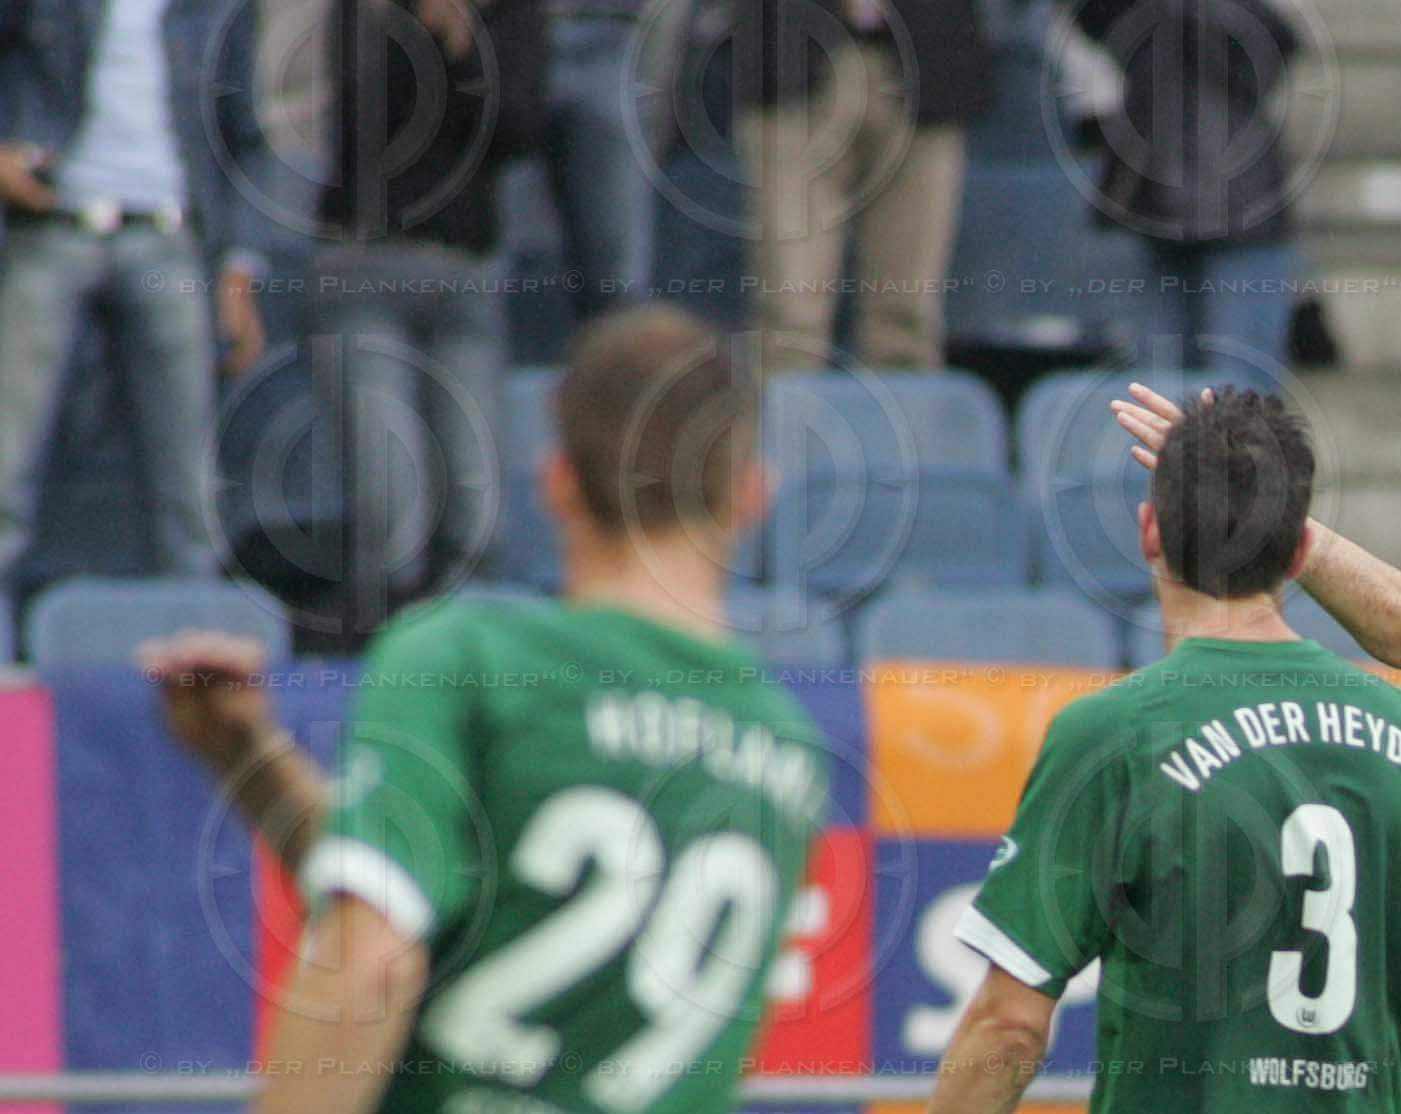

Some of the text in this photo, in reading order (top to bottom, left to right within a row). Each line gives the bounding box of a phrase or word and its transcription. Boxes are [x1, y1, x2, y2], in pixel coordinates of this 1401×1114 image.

[1159, 719, 1241, 792] VAN
[1233, 701, 1311, 749] DER
[1267, 803, 1358, 1036] 3
[1249, 1057, 1369, 1090] WOLFSBURG
